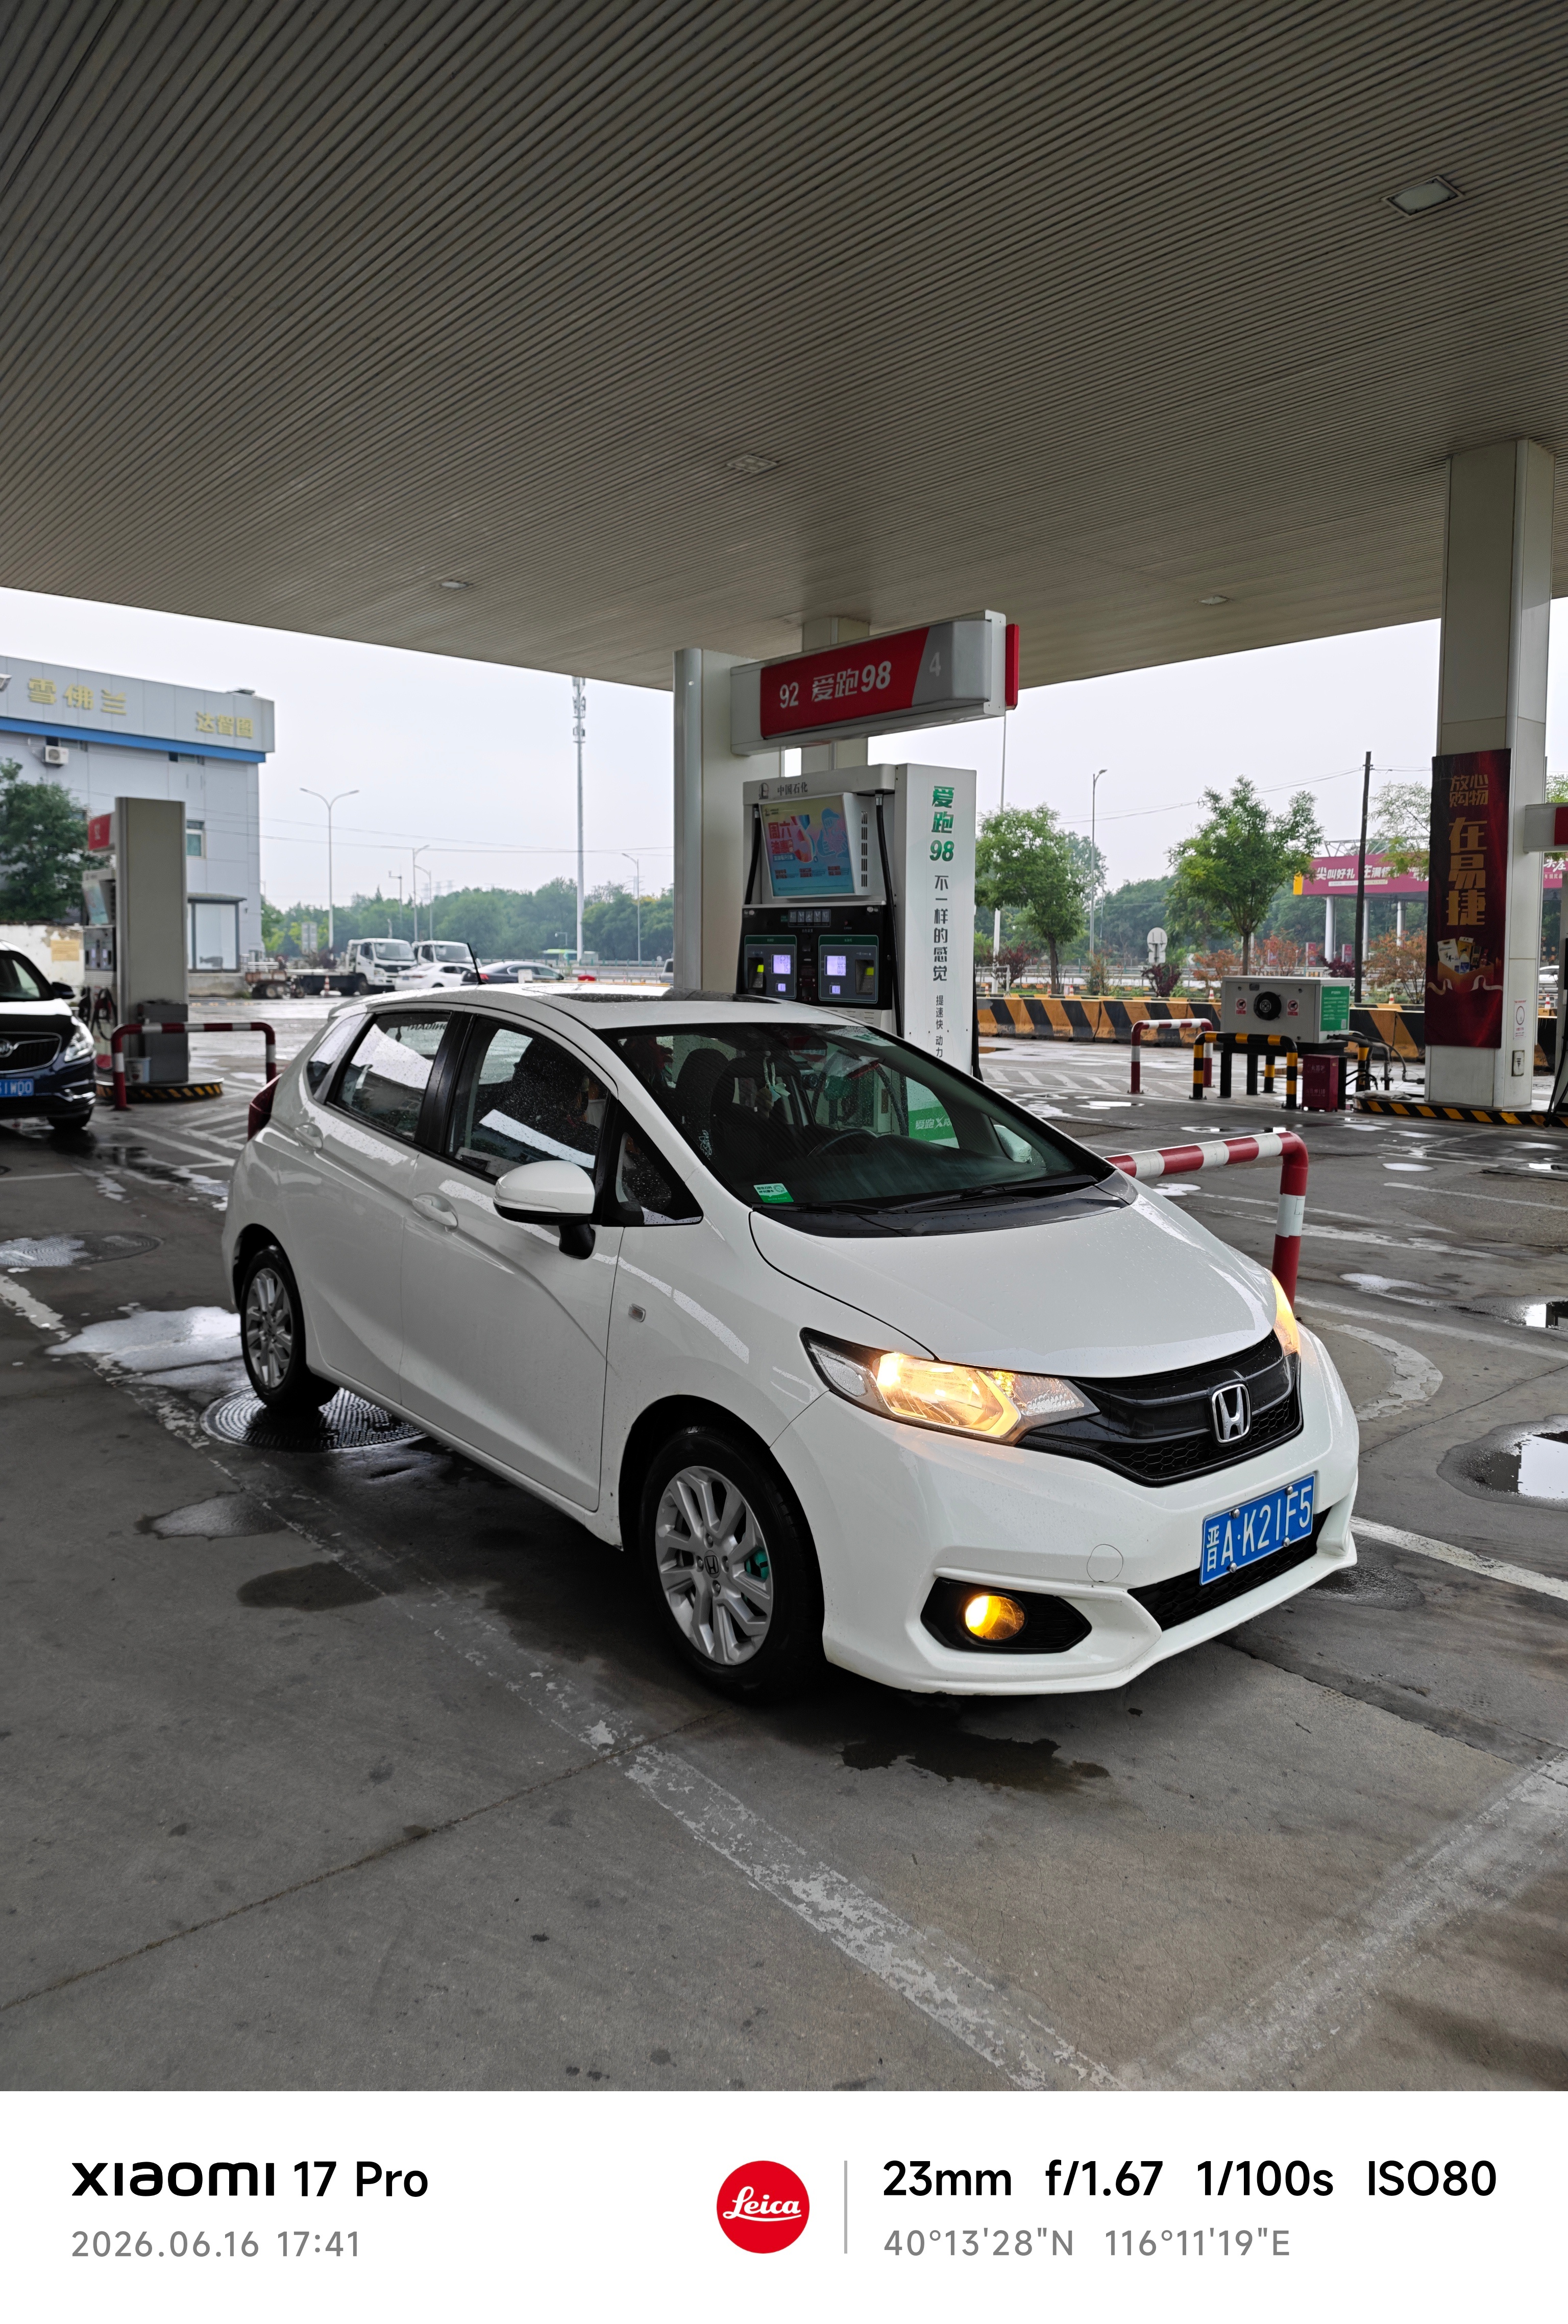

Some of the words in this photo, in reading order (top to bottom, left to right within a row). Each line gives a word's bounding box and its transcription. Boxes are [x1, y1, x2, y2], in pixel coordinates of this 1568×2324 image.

[779, 682, 799, 708] 92
[812, 661, 892, 702] 爱跑98
[929, 652, 941, 676] 4
[28, 677, 127, 715] 雪佛兰
[777, 782, 807, 796] 中国石化
[1450, 773, 1488, 791] 放心
[1449, 790, 1488, 808] 购物
[929, 786, 954, 861] 爱跑98
[1316, 866, 1355, 880] 尖叫好礼
[1447, 817, 1487, 926] 在易捷
[933, 875, 948, 981] 不一样的感觉
[936, 1035, 943, 1057] 动力
